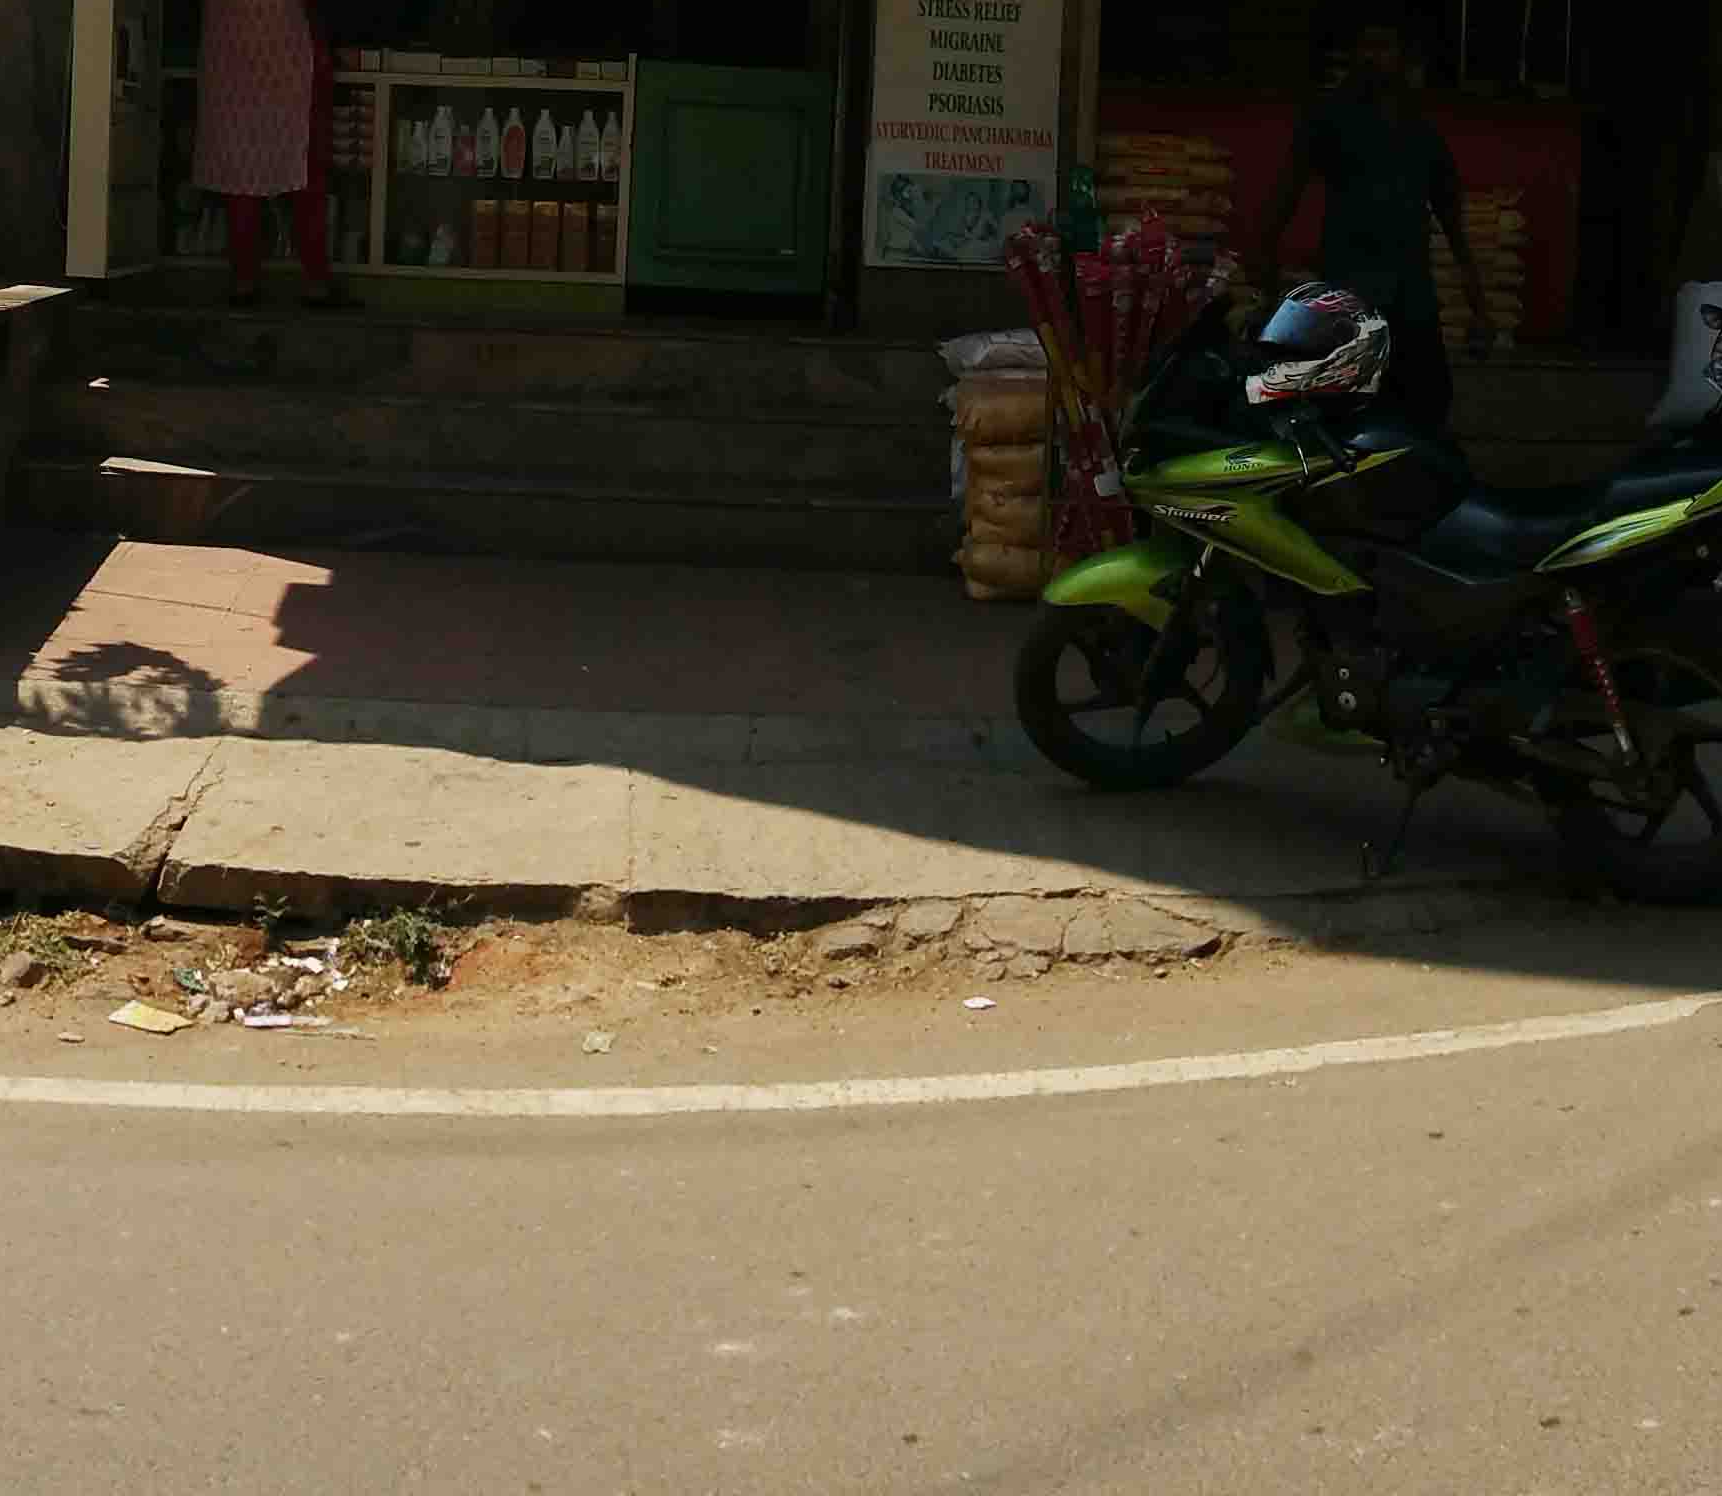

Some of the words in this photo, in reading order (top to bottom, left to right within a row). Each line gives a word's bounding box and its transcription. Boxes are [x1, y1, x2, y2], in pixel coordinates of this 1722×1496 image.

[974, 0, 1022, 23] RELIEF
[929, 29, 1005, 53] MIGRAINE
[932, 61, 1003, 84] DIABETES
[927, 92, 1005, 115] PSORIASIS
[1153, 503, 1231, 522] Stunner
